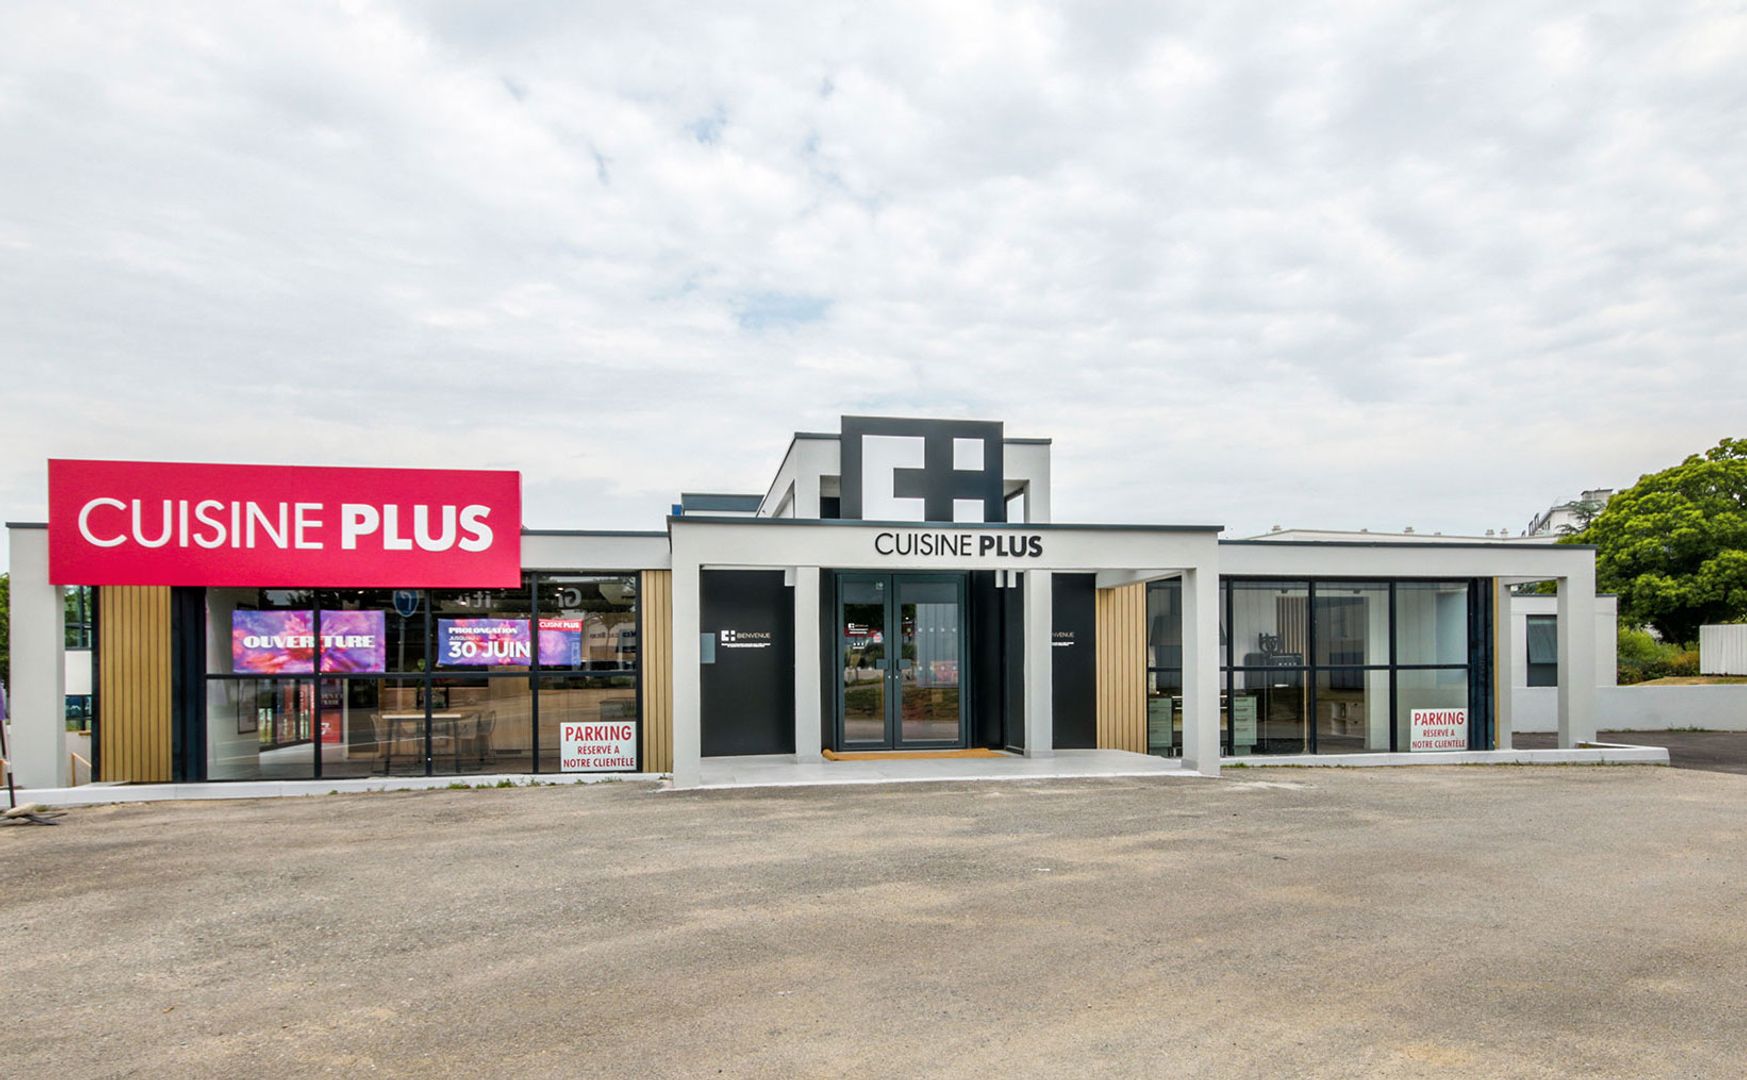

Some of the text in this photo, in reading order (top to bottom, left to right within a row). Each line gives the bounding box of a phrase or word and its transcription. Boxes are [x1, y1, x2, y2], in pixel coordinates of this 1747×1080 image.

[77, 496, 494, 553] CUISINE PLUS
[874, 532, 1043, 558] CUISINE PLUS
[448, 641, 531, 658] 30 JUIN
[1414, 711, 1464, 726] PARKING
[565, 725, 632, 741] PARKING
[1412, 740, 1433, 749] NOTRE
[563, 758, 591, 768] NOTRE
